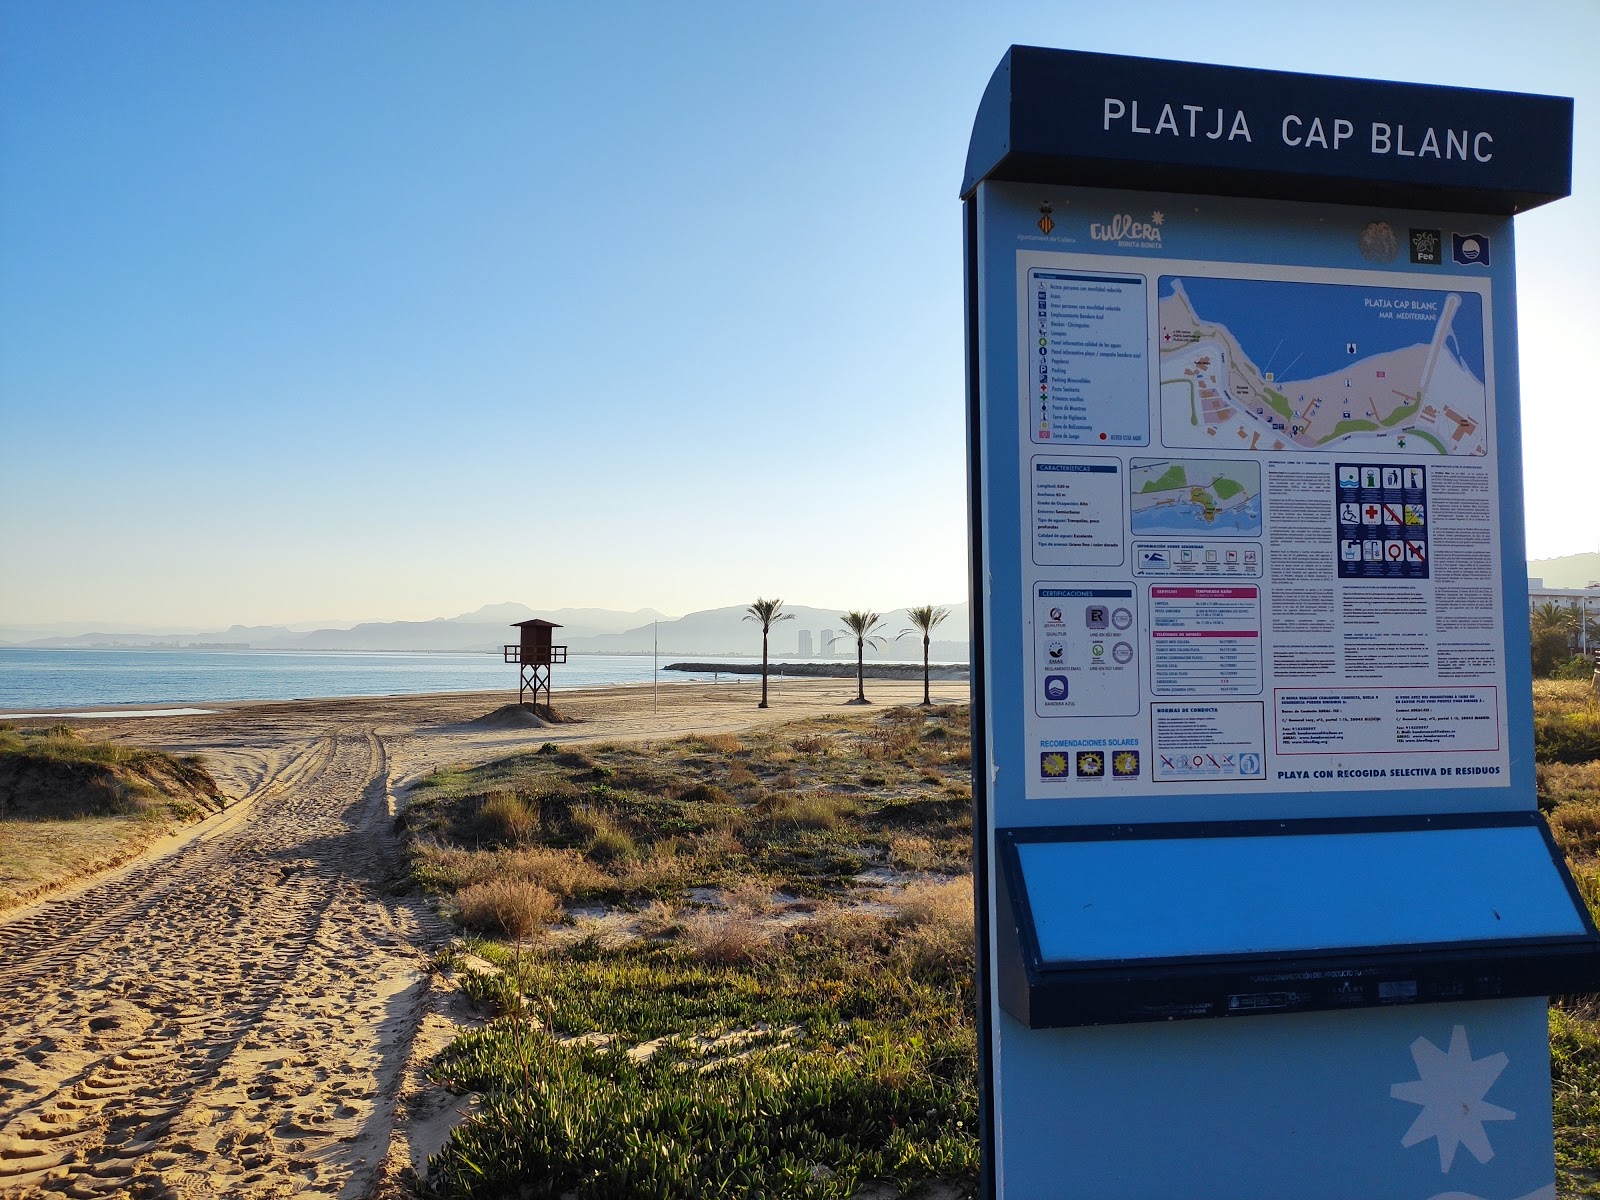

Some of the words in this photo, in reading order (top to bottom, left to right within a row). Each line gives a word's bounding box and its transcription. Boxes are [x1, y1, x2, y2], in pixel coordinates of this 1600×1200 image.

[1103, 97, 1252, 143] PLATJA
[1281, 114, 1354, 150] CAP
[1371, 123, 1494, 163] BLANC
[1418, 253, 1434, 261] Fee
[1364, 298, 1392, 308] PLATJA
[1394, 300, 1410, 309] CAP
[1412, 301, 1437, 310] BLANC
[1396, 313, 1436, 321] MEDITERRANI
[1278, 771, 1310, 779] PLAYA
[1313, 770, 1333, 778] CON
[1337, 769, 1387, 778] RECOGIDA
[1390, 768, 1437, 777] SELECTIVA
[1440, 768, 1452, 776] DE
[1456, 766, 1500, 775] RESIDUOS
